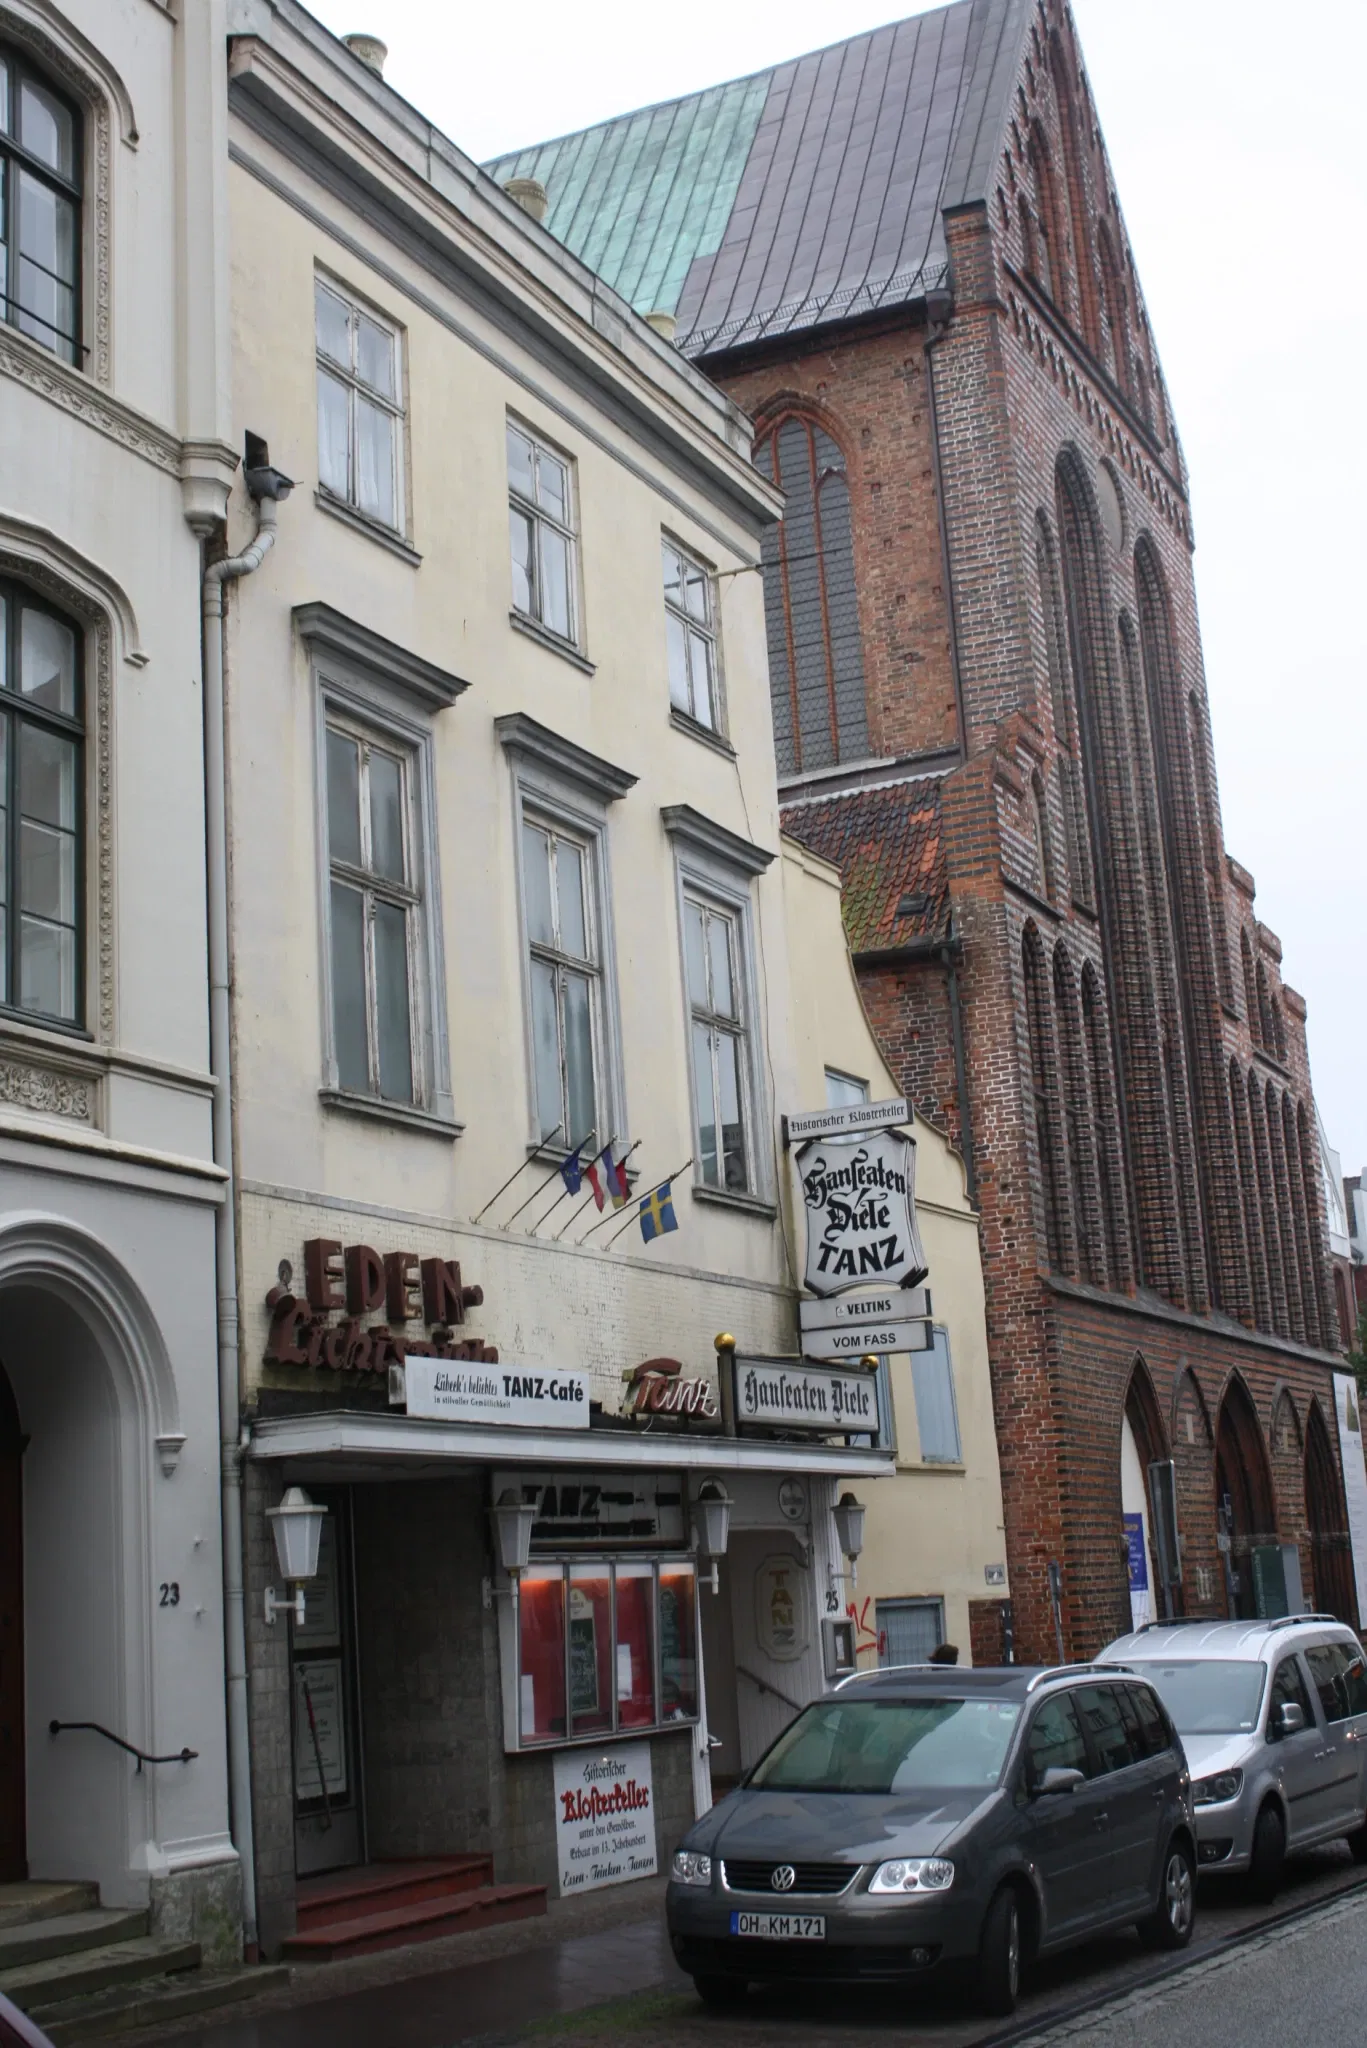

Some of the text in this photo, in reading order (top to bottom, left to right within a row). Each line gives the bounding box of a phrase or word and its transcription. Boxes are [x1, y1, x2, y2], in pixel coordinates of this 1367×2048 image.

[790, 1105, 905, 1132] Historischer Klosterkeller
[803, 1148, 906, 1210] Hanseaten
[824, 1187, 890, 1242] Diele
[817, 1234, 905, 1276] TANZ
[847, 1300, 892, 1315] VELTINS
[833, 1333, 896, 1348] VOM FASS
[469, 1377, 498, 1396] beliebtes
[502, 1375, 584, 1402] TANZ-Café
[745, 1369, 869, 1423] Hanseaten Diele
[521, 1485, 600, 1517] TANZ
[159, 1582, 180, 1607] 23
[825, 1590, 839, 1612] 25
[560, 1779, 650, 1824] Klosterkeller
[563, 1871, 584, 1888] Essen
[591, 1860, 621, 1881] Trinken
[739, 1914, 824, 1936] OH KM 171
